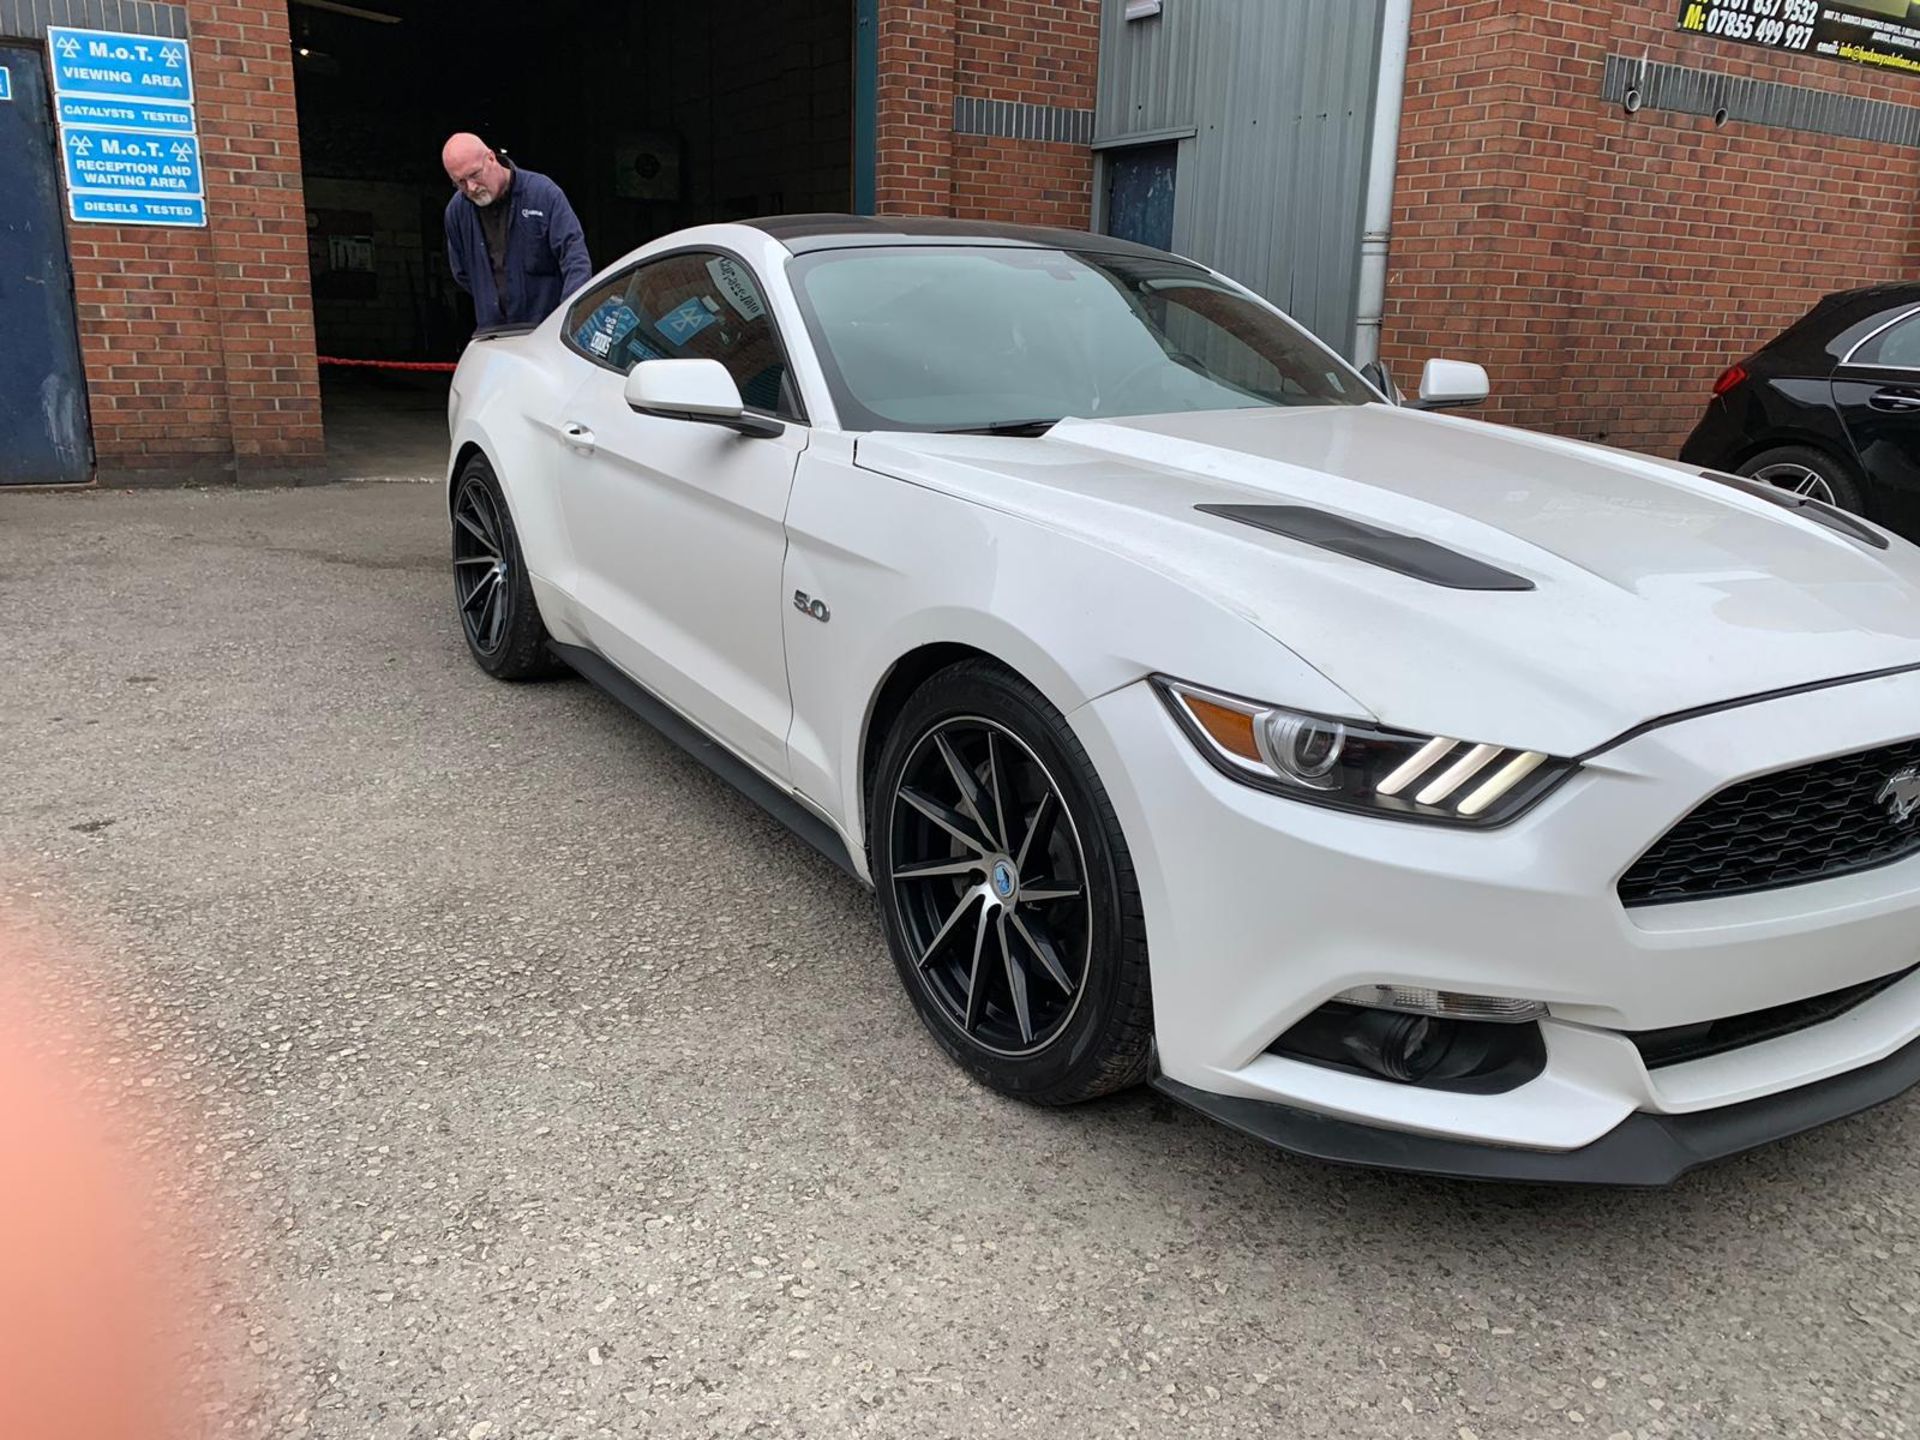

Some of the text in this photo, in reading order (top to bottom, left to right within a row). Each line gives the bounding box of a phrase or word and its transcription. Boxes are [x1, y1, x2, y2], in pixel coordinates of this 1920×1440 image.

[1683, 4, 1706, 30] M:
[1706, 8, 1756, 39] 07855
[1755, 18, 1783, 44] 499
[1784, 24, 1814, 49] 927
[89, 42, 153, 62] M.o.T.
[63, 67, 182, 88] VIEWING AREA
[64, 105, 188, 123] CATALYSTS TESTED
[101, 139, 164, 157] M.o.T.
[76, 160, 191, 177] RECEPTION AND
[84, 173, 187, 189] WAITING AREA
[84, 201, 193, 216] DIESELS TESTED
